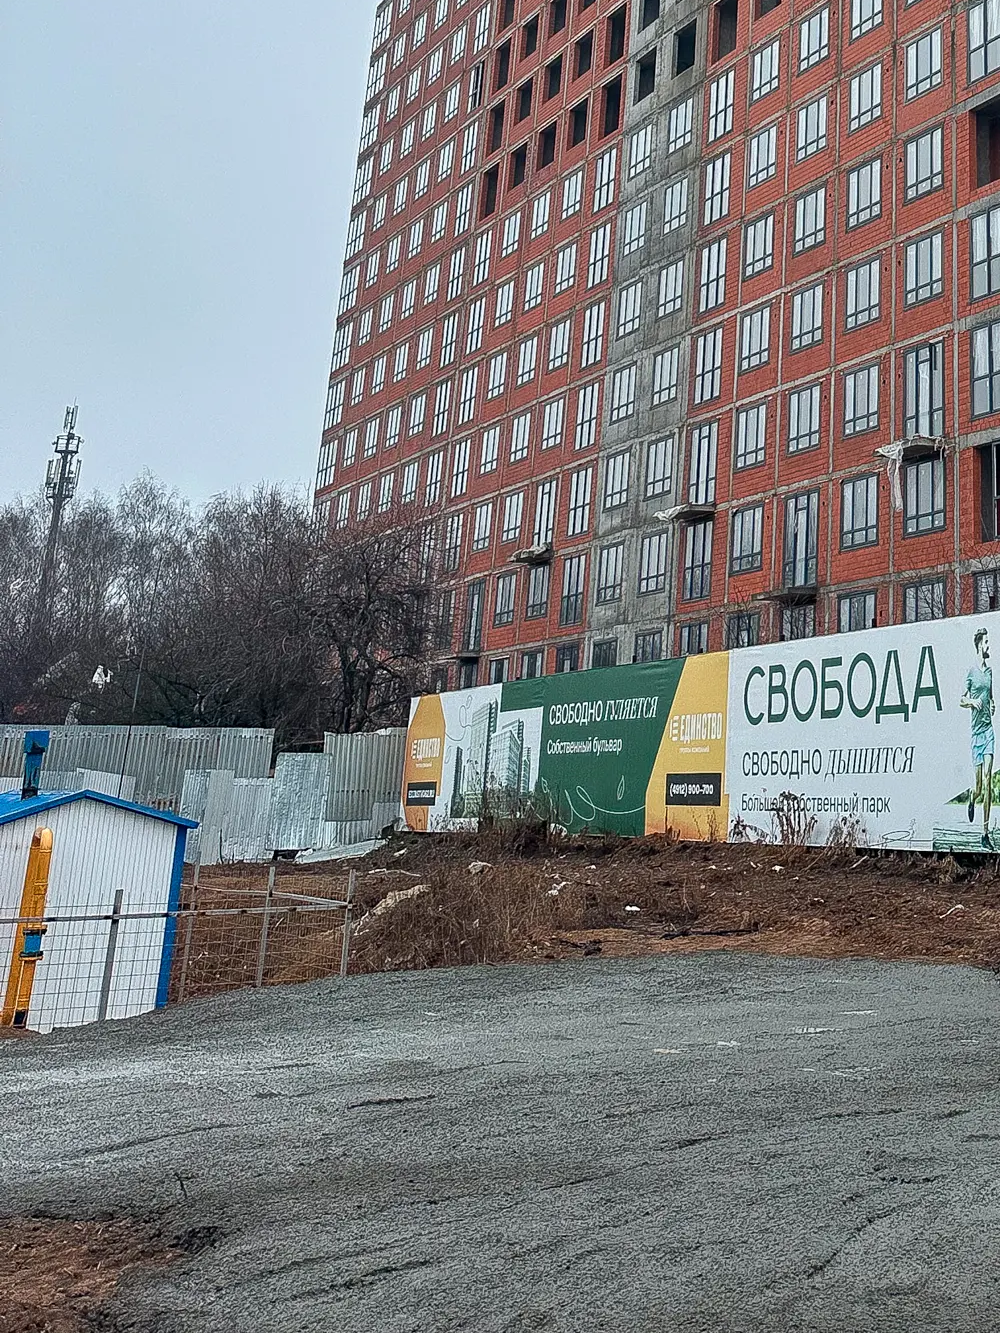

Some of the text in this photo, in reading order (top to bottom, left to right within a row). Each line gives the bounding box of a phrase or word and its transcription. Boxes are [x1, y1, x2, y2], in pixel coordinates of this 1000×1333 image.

[743, 645, 943, 725] СВОБОДА
[549, 696, 659, 726] СВОБОДНО ГУЛЯЕТСЯ
[680, 713, 723, 744] ЕДИНСТВО
[547, 737, 623, 757] Собственный бульвар
[742, 746, 916, 783] СВОБОДНО ДЫШИТСЯ
[669, 783, 688, 797] (4912)
[862, 796, 891, 818] парк
